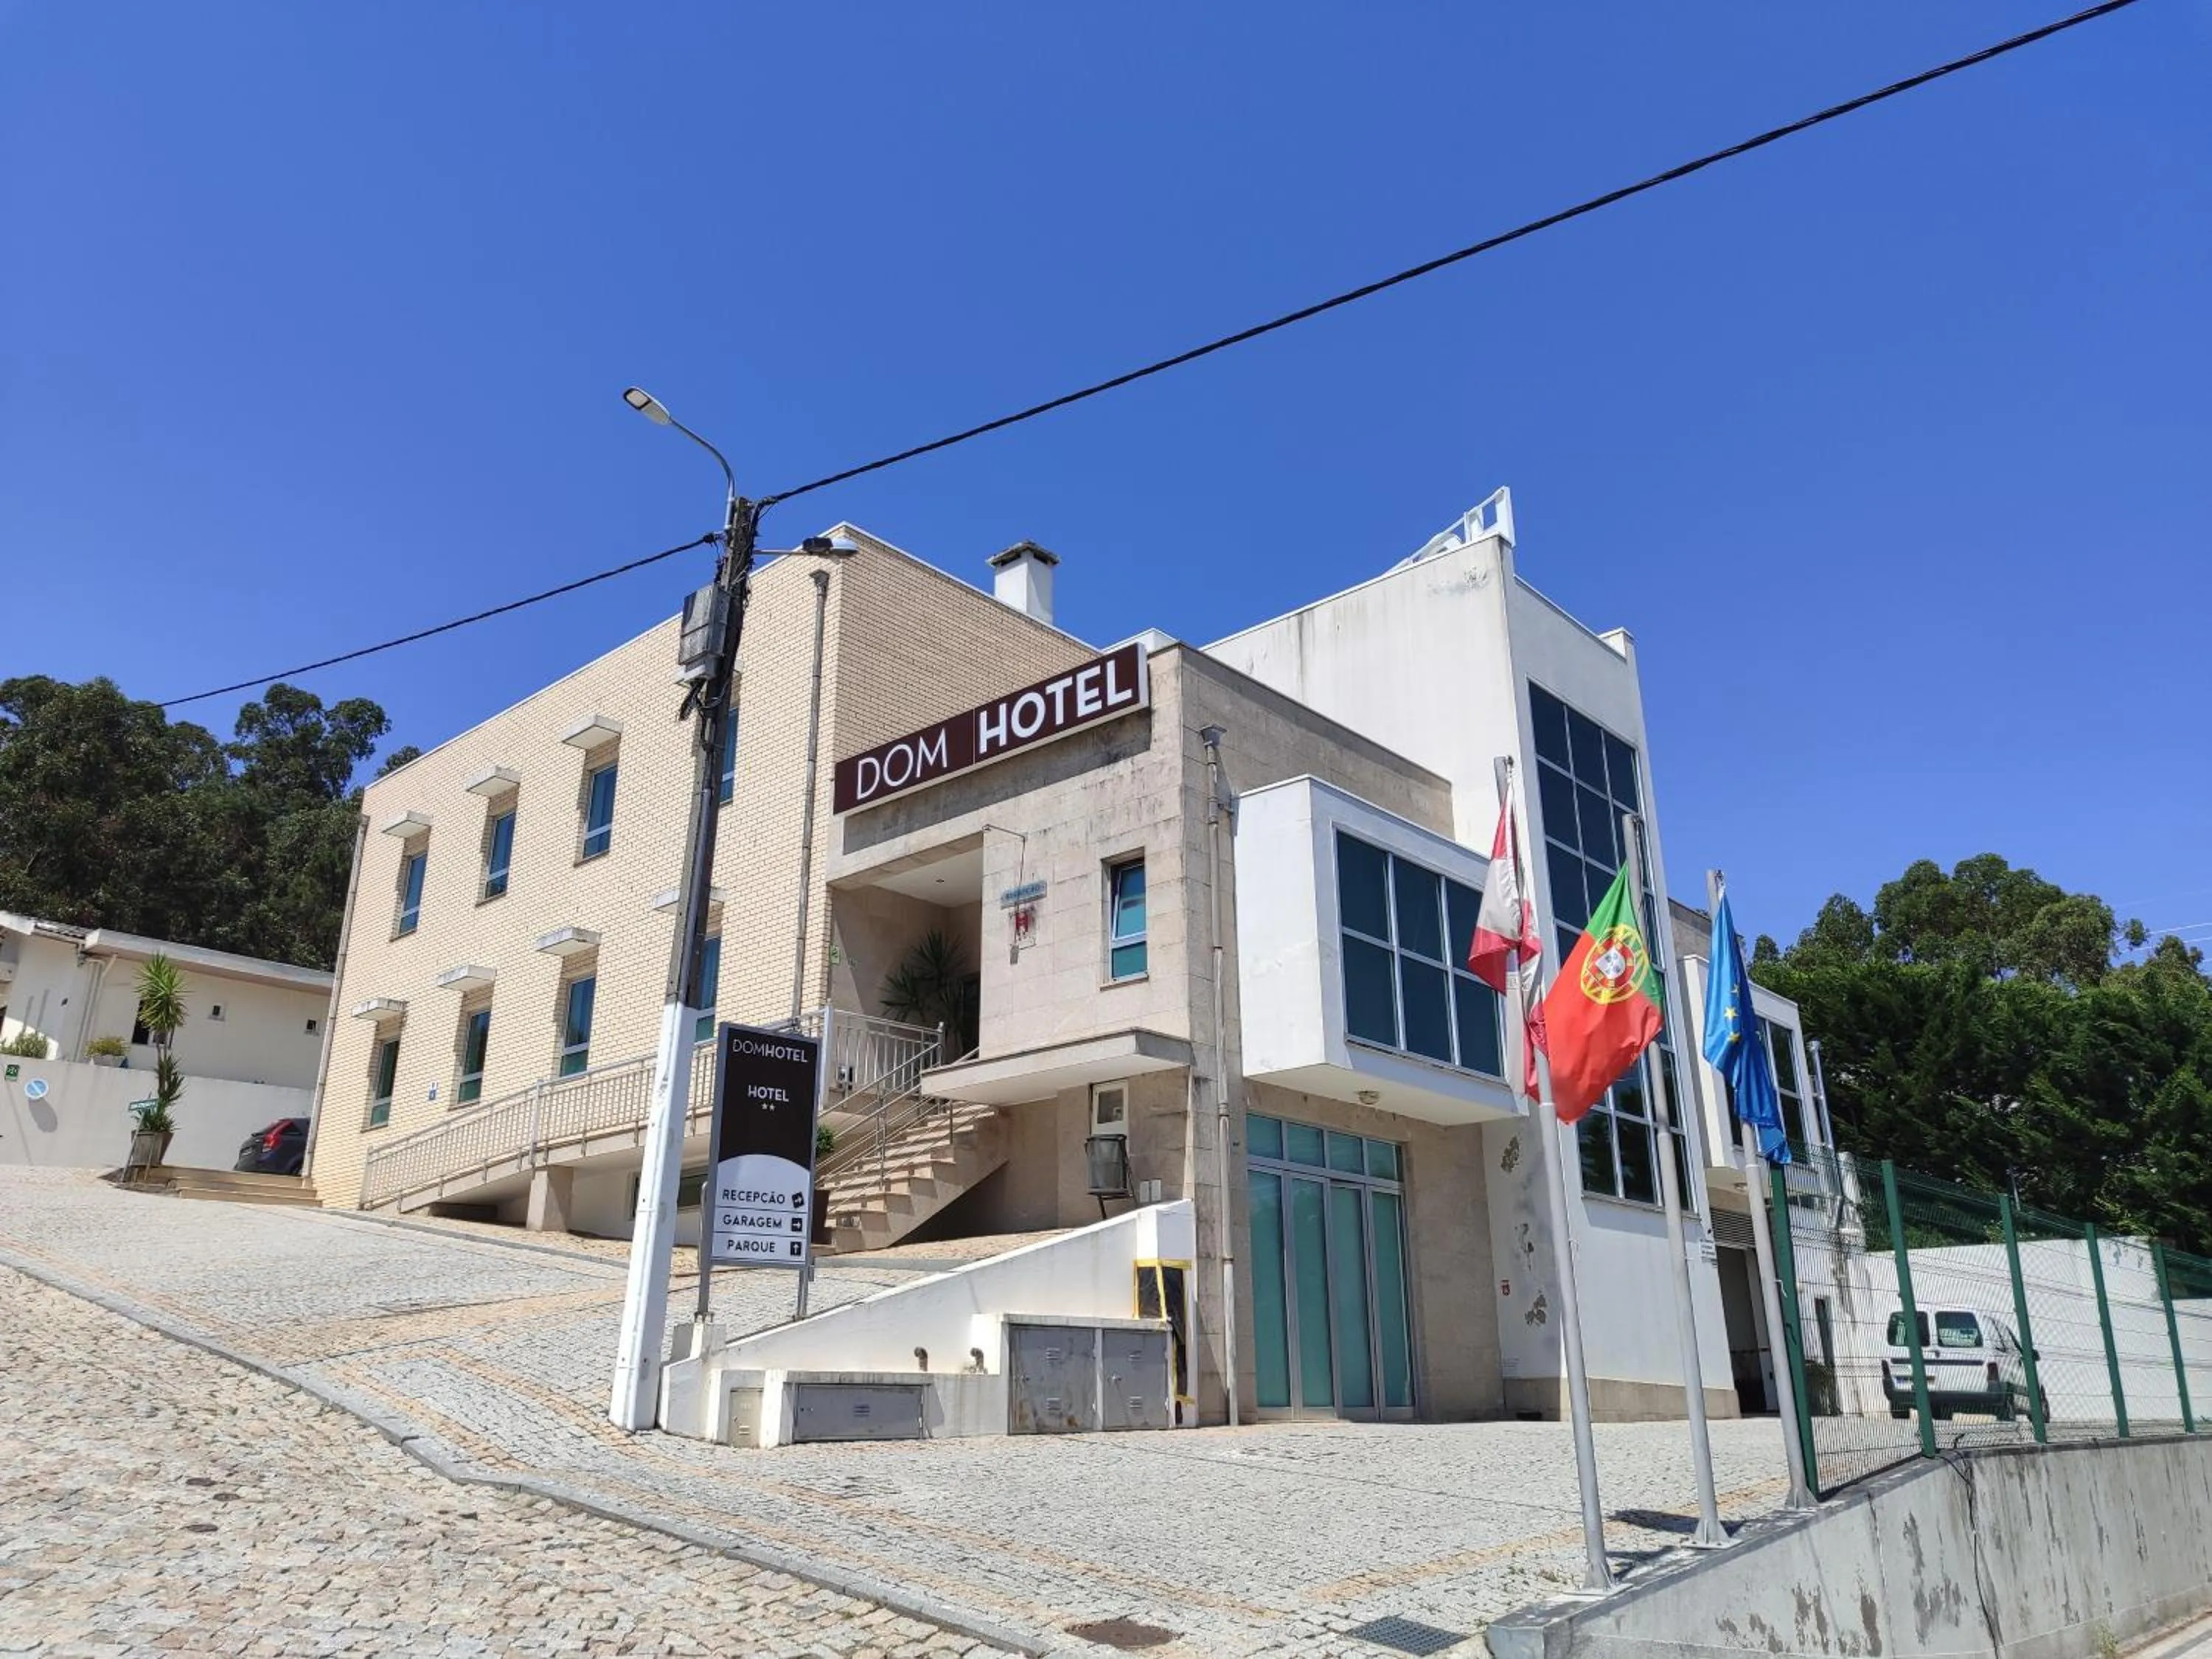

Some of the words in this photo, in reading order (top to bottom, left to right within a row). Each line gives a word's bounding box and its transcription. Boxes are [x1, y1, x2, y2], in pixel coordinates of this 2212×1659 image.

[857, 728, 947, 801] DOM
[978, 659, 1133, 754] HOTEL
[748, 1085, 790, 1102] HOTEL
[723, 1214, 782, 1229] GARAGEM
[726, 1239, 776, 1253] PARQUE
